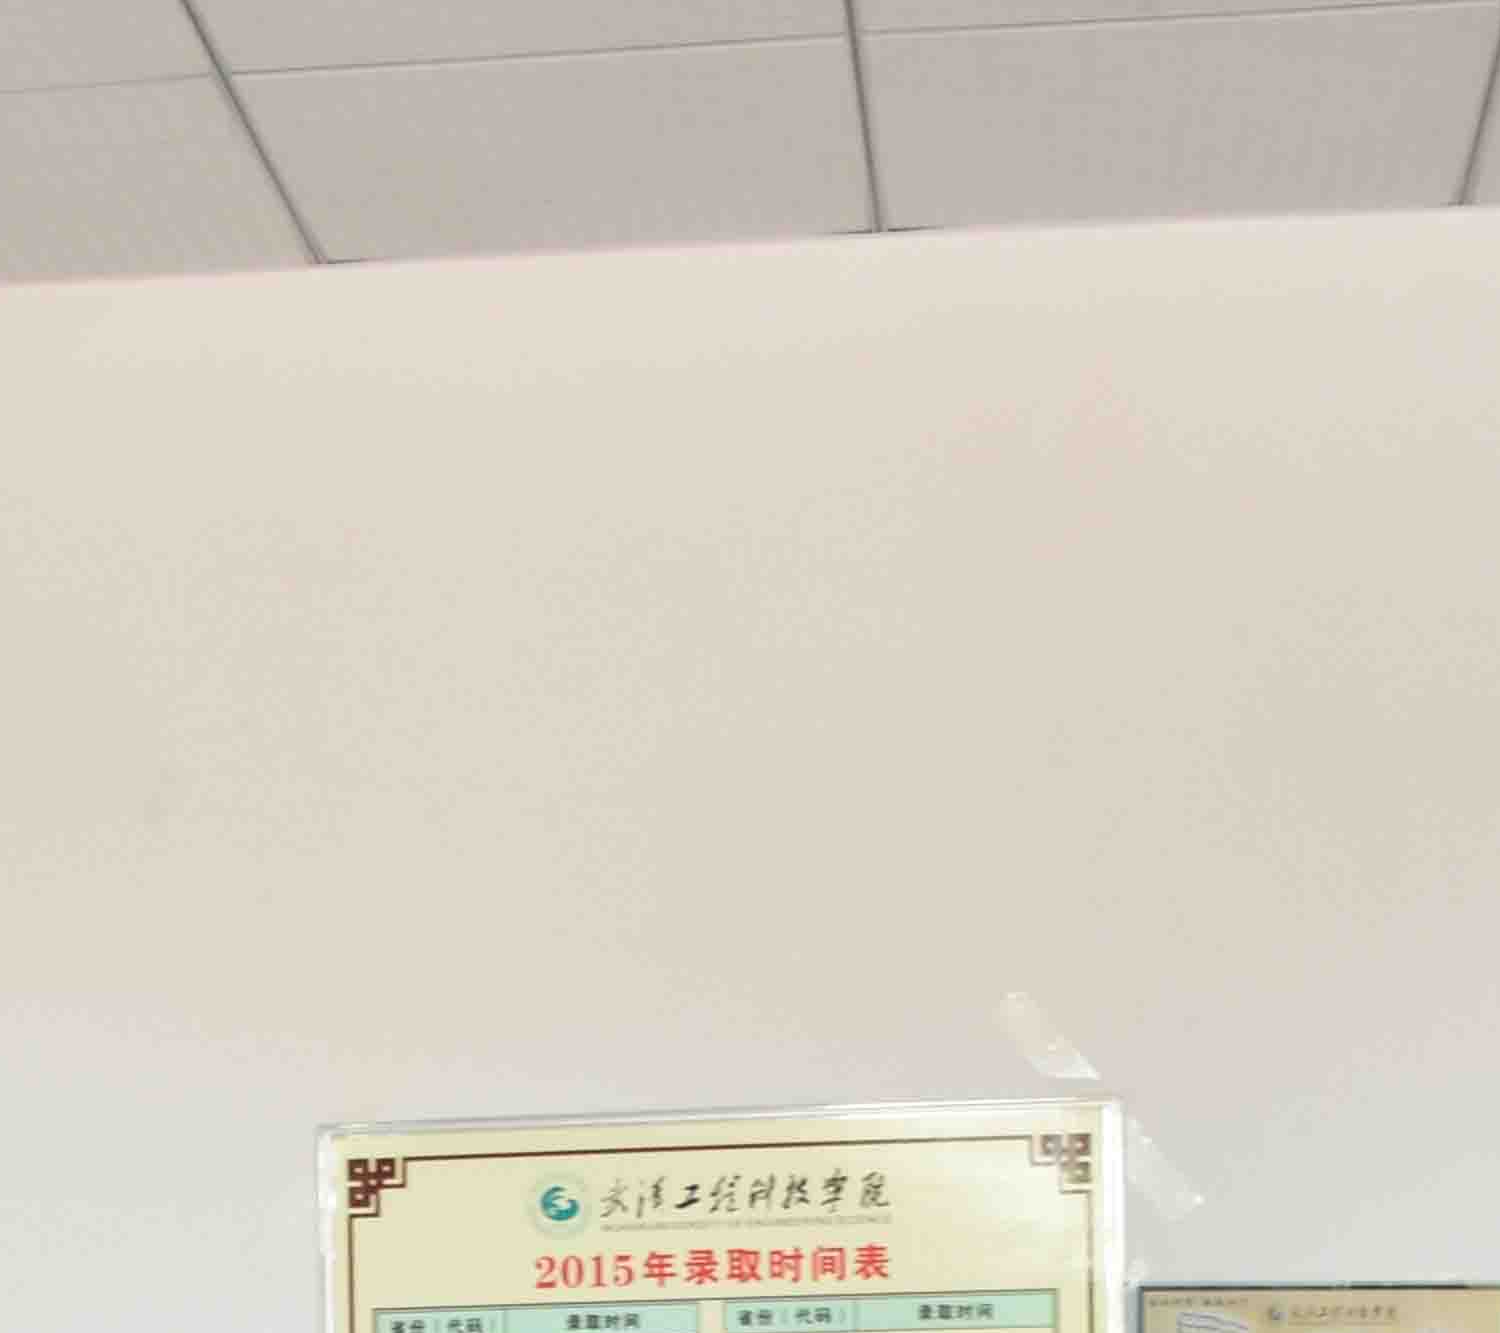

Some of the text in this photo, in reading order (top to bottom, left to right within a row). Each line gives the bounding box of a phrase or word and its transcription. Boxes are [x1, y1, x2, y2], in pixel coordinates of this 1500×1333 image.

[534, 1244, 890, 1289] 2015年录取时间表
[918, 1303, 996, 1321] 录取时间
[566, 1313, 641, 1331] 录取时间
